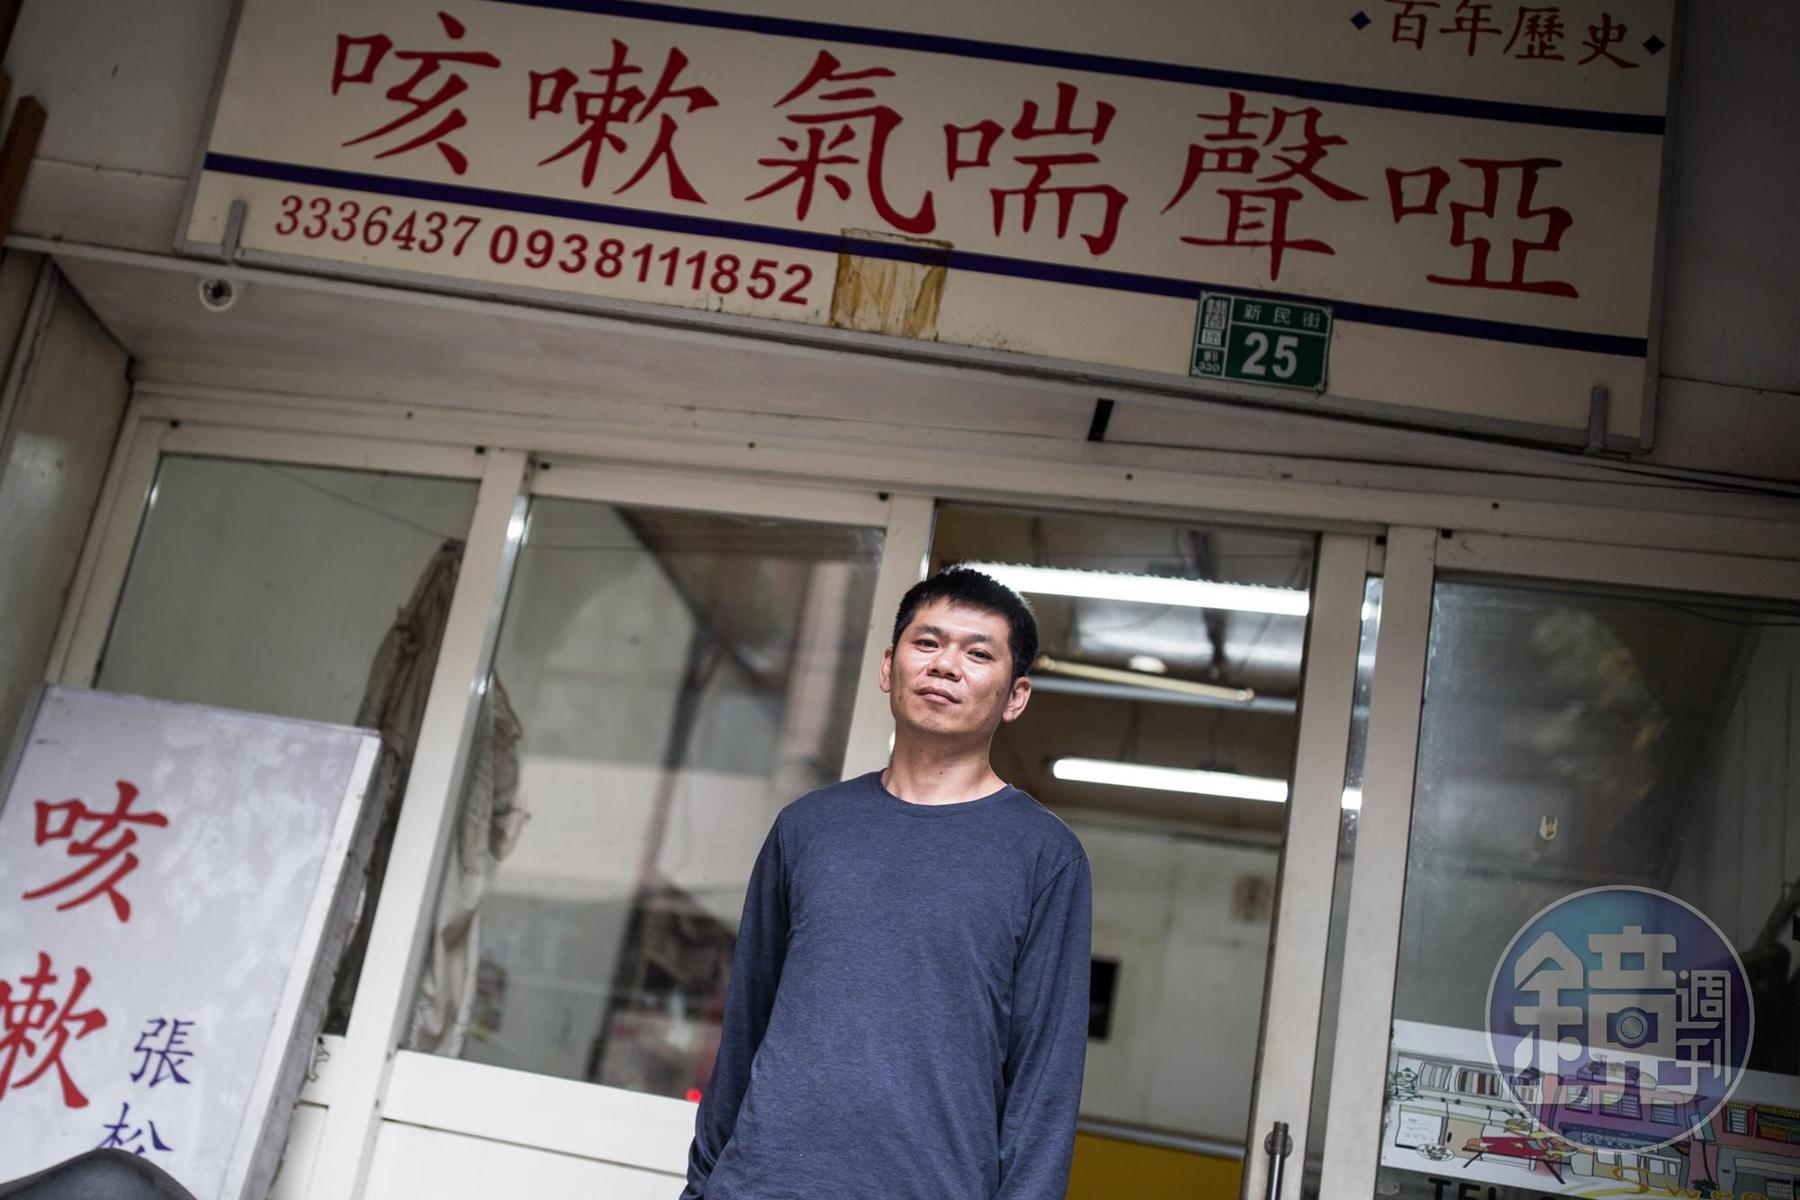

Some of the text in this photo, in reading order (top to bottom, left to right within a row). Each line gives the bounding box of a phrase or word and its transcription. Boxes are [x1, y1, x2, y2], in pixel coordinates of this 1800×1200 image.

[1386, 0, 1640, 69] 百年歷史
[331, 11, 1580, 299] 咳嗽氣喘聲啞
[274, 194, 813, 304] 3336437 0938111852
[1241, 331, 1299, 379] 25
[1243, 304, 1321, 329] 新民街
[0, 780, 169, 1109] 咳嗽
